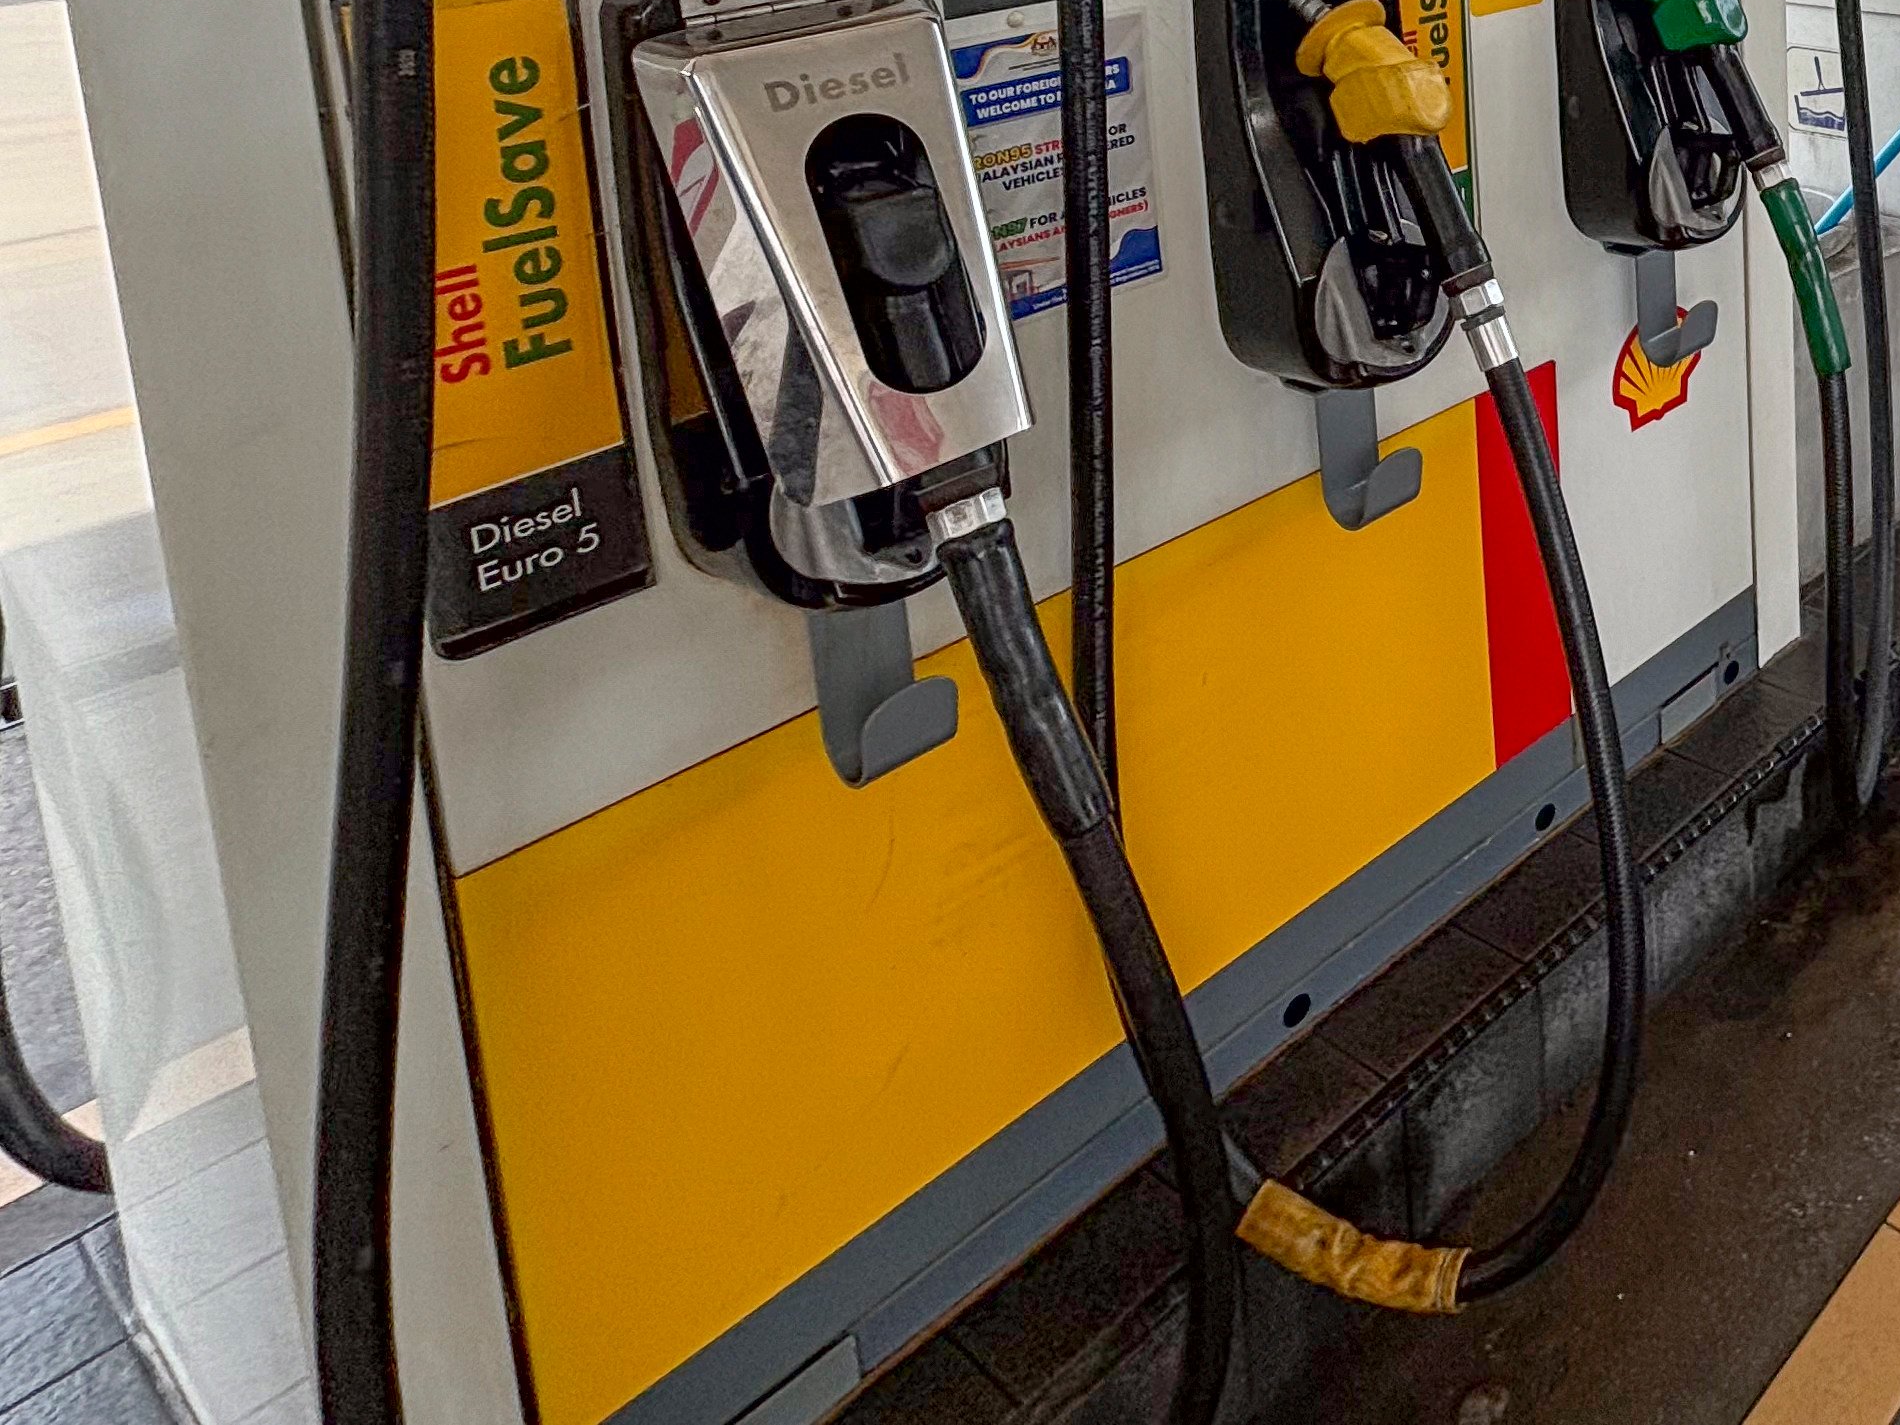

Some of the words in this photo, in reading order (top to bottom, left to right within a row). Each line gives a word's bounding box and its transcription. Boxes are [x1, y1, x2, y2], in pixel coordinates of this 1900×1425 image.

[763, 52, 911, 114] Diesel
[969, 92, 987, 105] TO
[988, 87, 1015, 101] OUR
[1015, 76, 1062, 95] FOREIG
[976, 97, 1038, 119] WELCOME
[1040, 93, 1055, 105] TO
[1108, 123, 1127, 135] OR
[977, 155, 1055, 183] ALAYSIAN
[483, 54, 574, 370] FuelSave
[1029, 211, 1057, 229] FOR
[1108, 187, 1147, 206] ICLES
[435, 262, 492, 384] Shell
[469, 488, 582, 555] Diesel
[476, 536, 564, 593] Euro
[577, 522, 601, 556] 5
